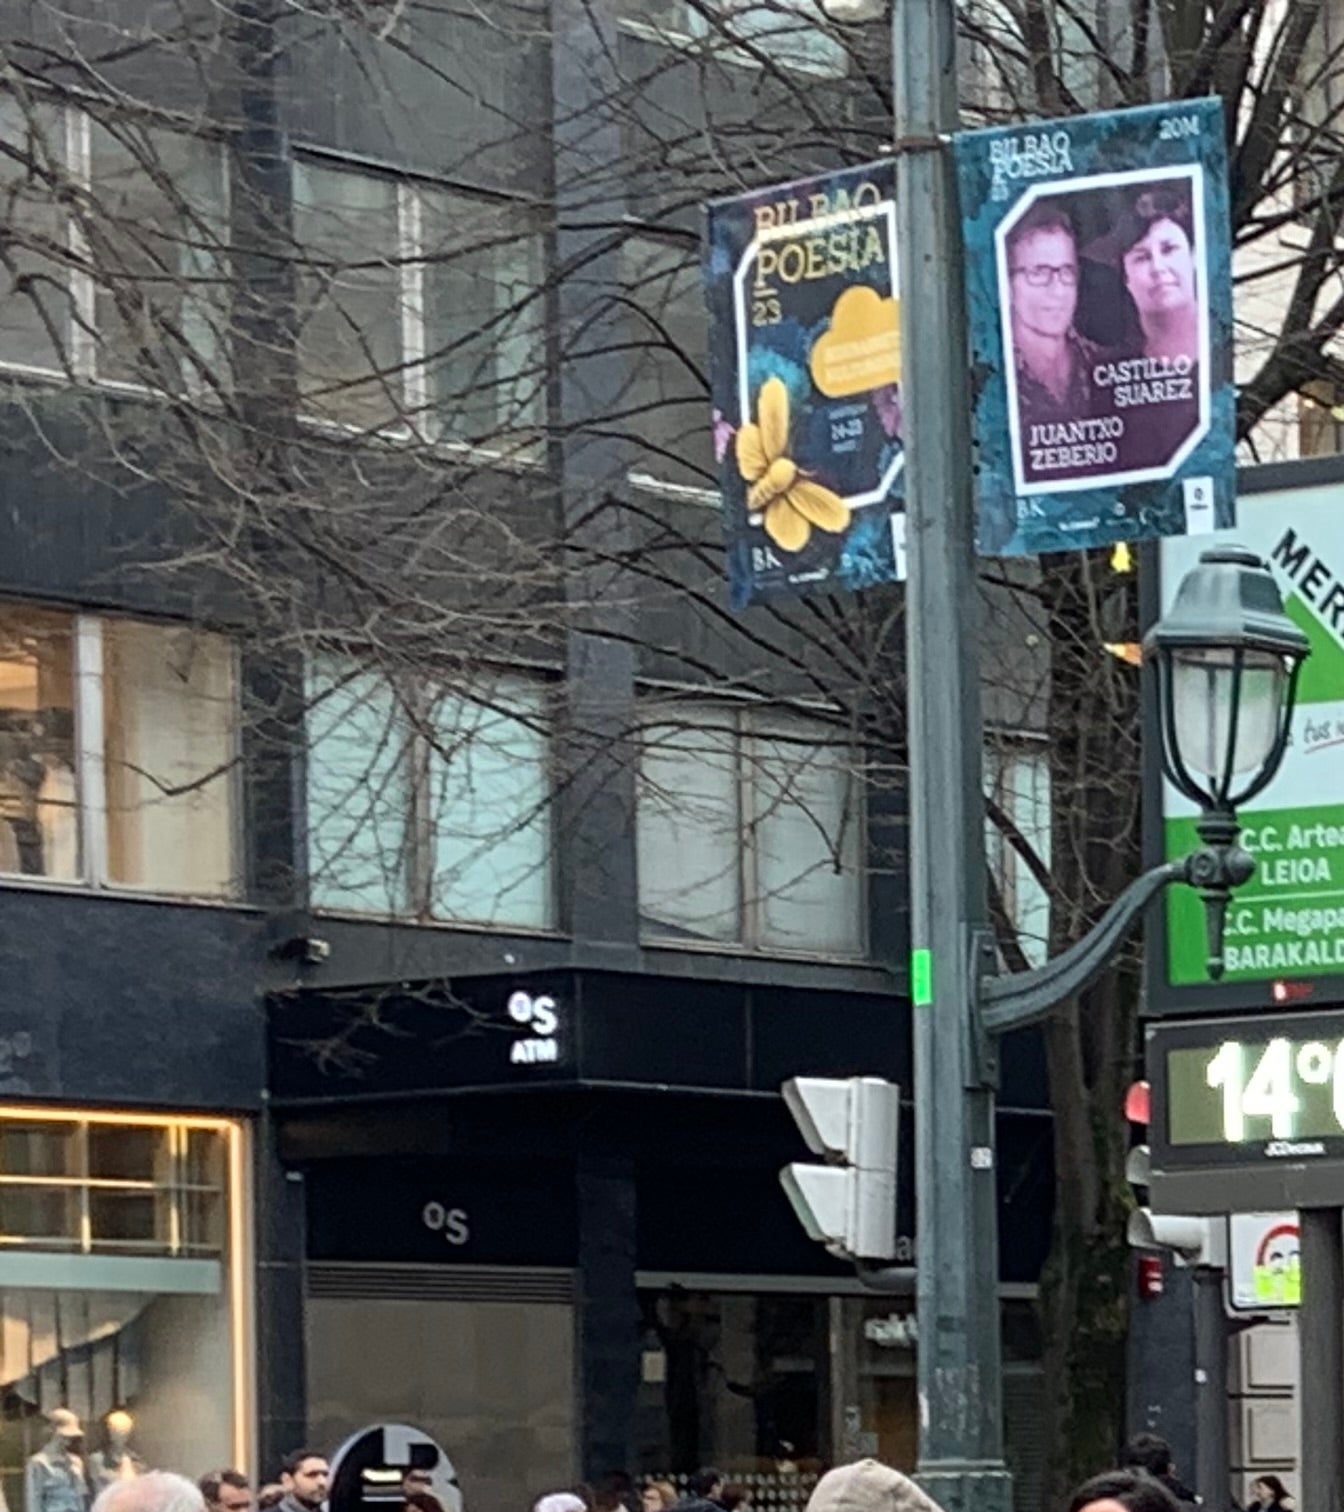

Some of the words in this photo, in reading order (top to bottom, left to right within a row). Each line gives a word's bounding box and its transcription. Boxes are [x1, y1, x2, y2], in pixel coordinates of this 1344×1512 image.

[989, 131, 1071, 164] BILBAO
[754, 226, 885, 288] POESIA
[752, 299, 782, 327] 23
[1093, 354, 1193, 388] CASTILLO
[1113, 378, 1193, 407] SUAREZ
[1029, 416, 1124, 447] JUANTXO
[1029, 442, 1117, 470] ZEBERIO
[1261, 857, 1331, 885] LEIOA
[511, 1038, 557, 1064] ATM
